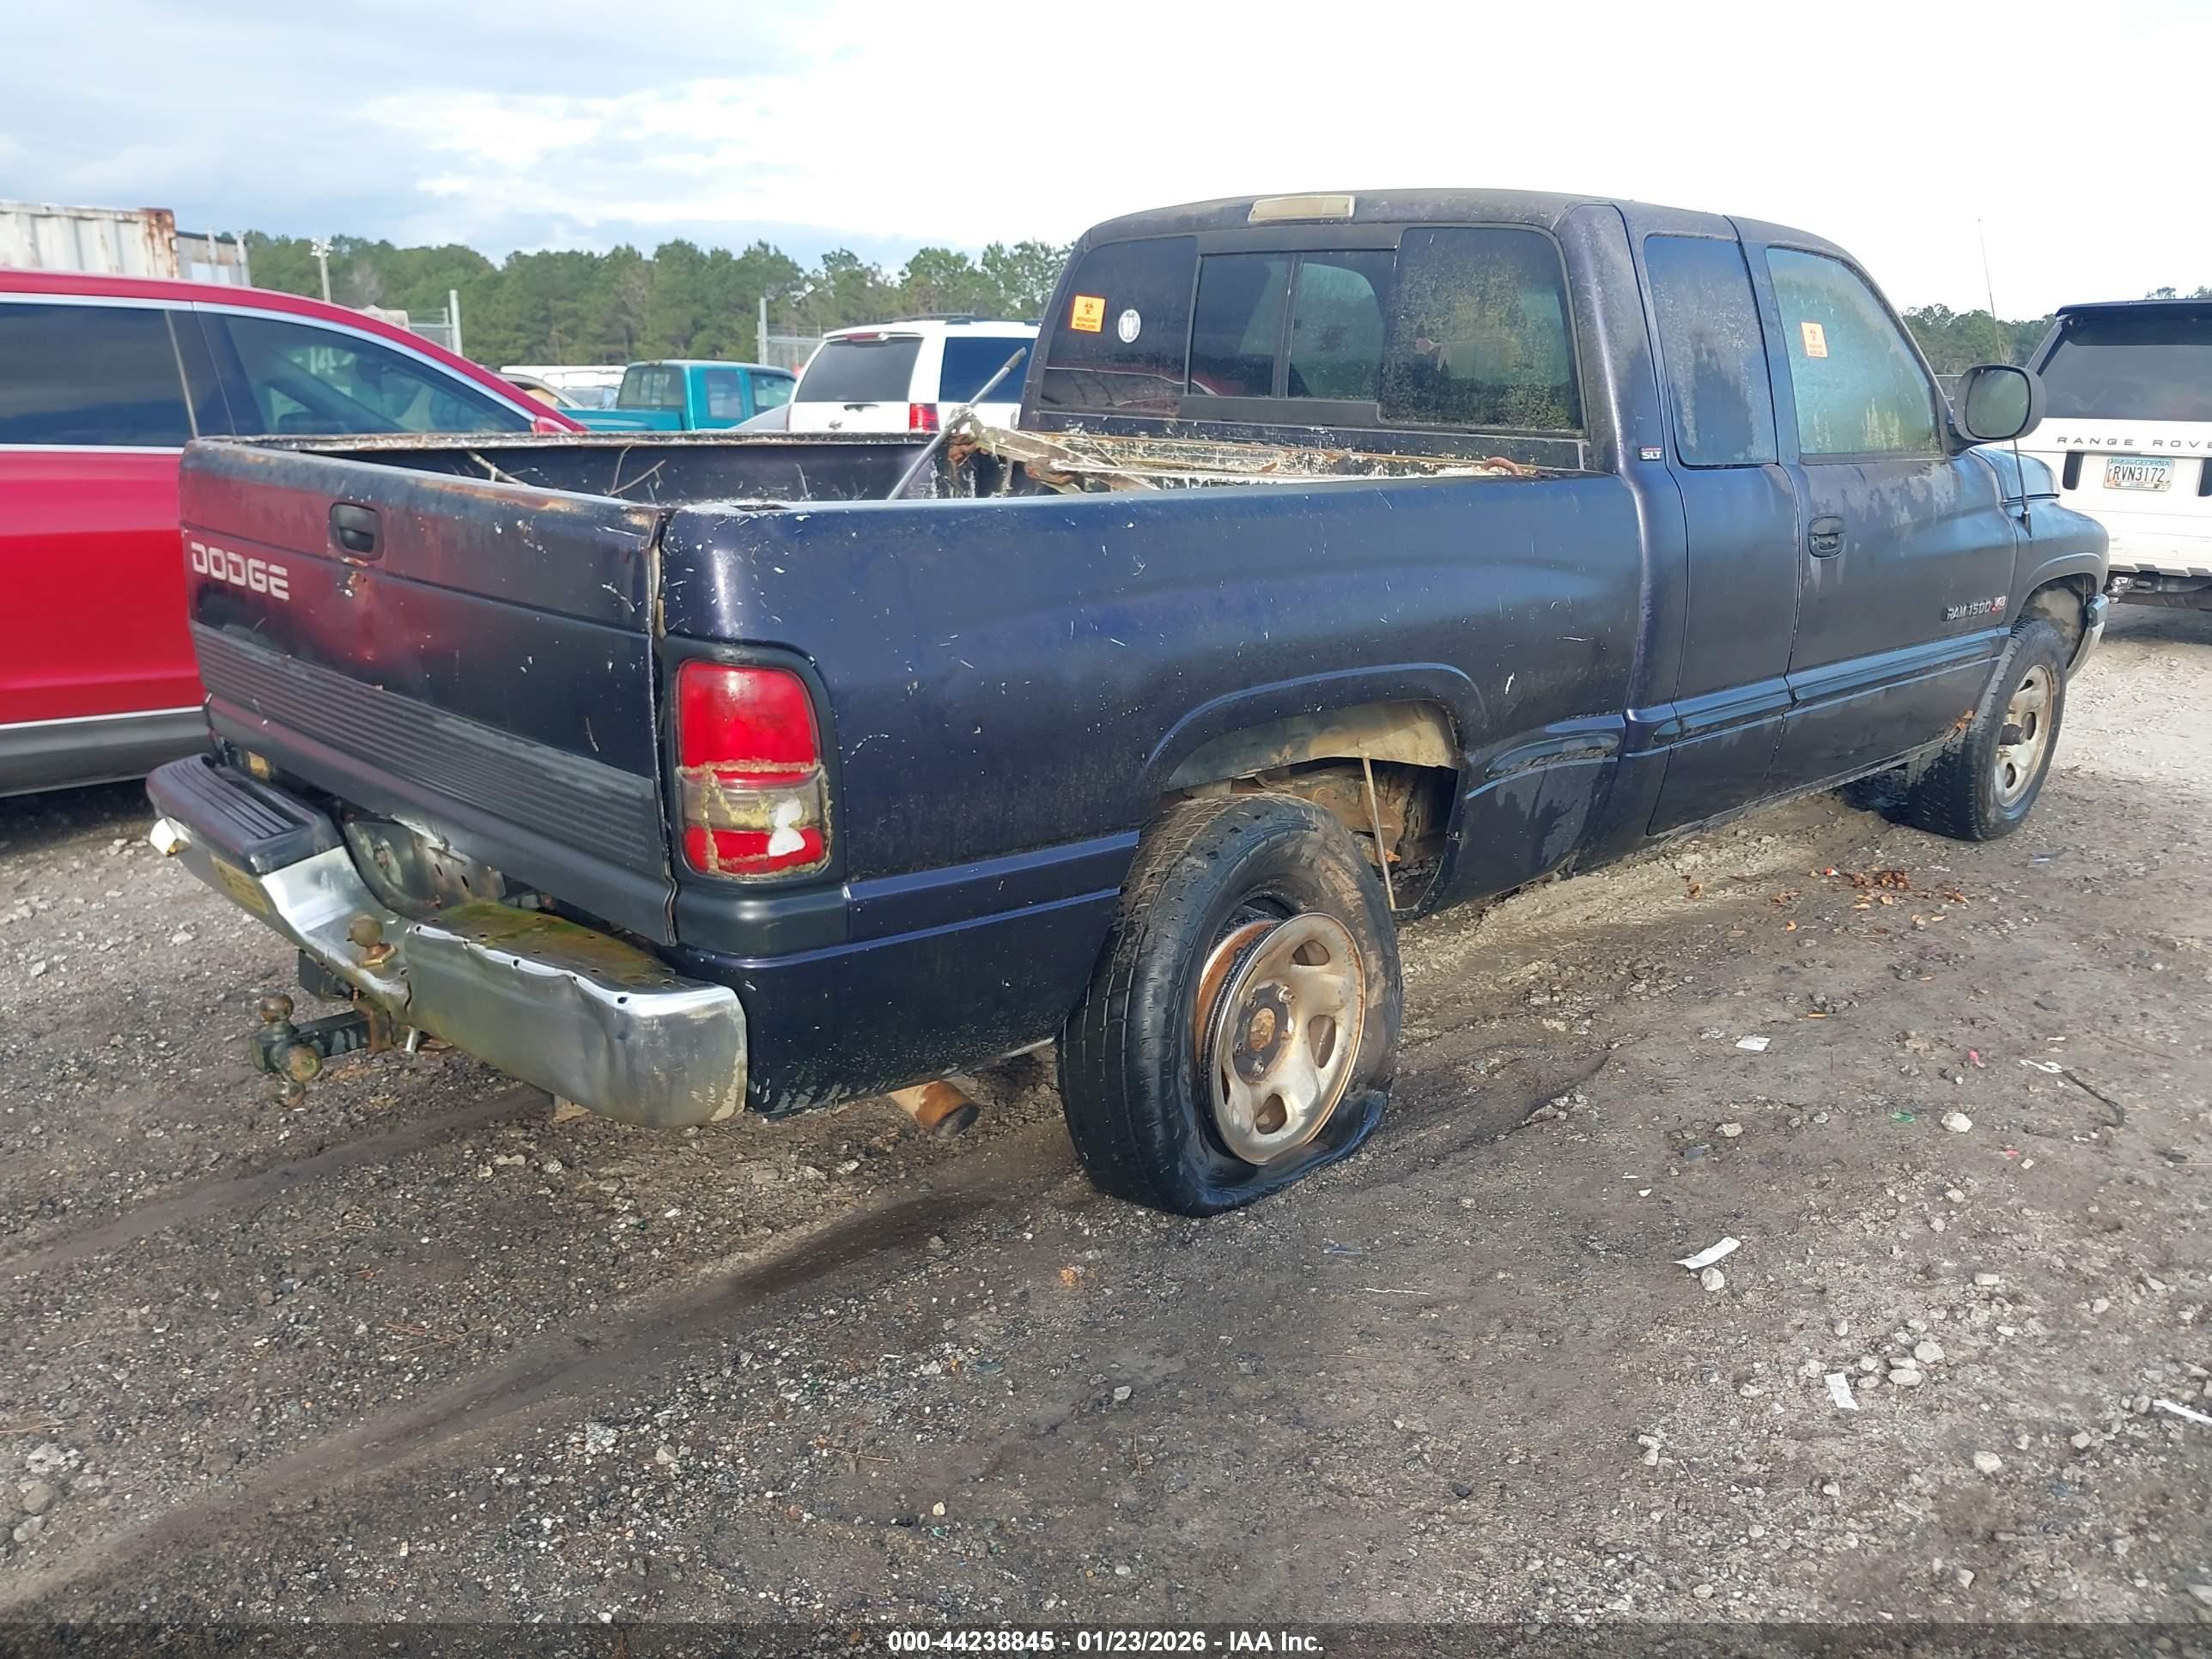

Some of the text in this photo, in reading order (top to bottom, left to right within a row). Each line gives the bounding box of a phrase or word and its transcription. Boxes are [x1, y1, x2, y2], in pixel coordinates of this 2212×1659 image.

[2057, 436, 2135, 446] RANGE
[1641, 451, 1662, 459] SLT
[2112, 465, 2166, 483] RVN3172
[191, 541, 289, 601] DODGE
[1947, 605, 1967, 620] RAM
[1967, 600, 1990, 616] 1500
